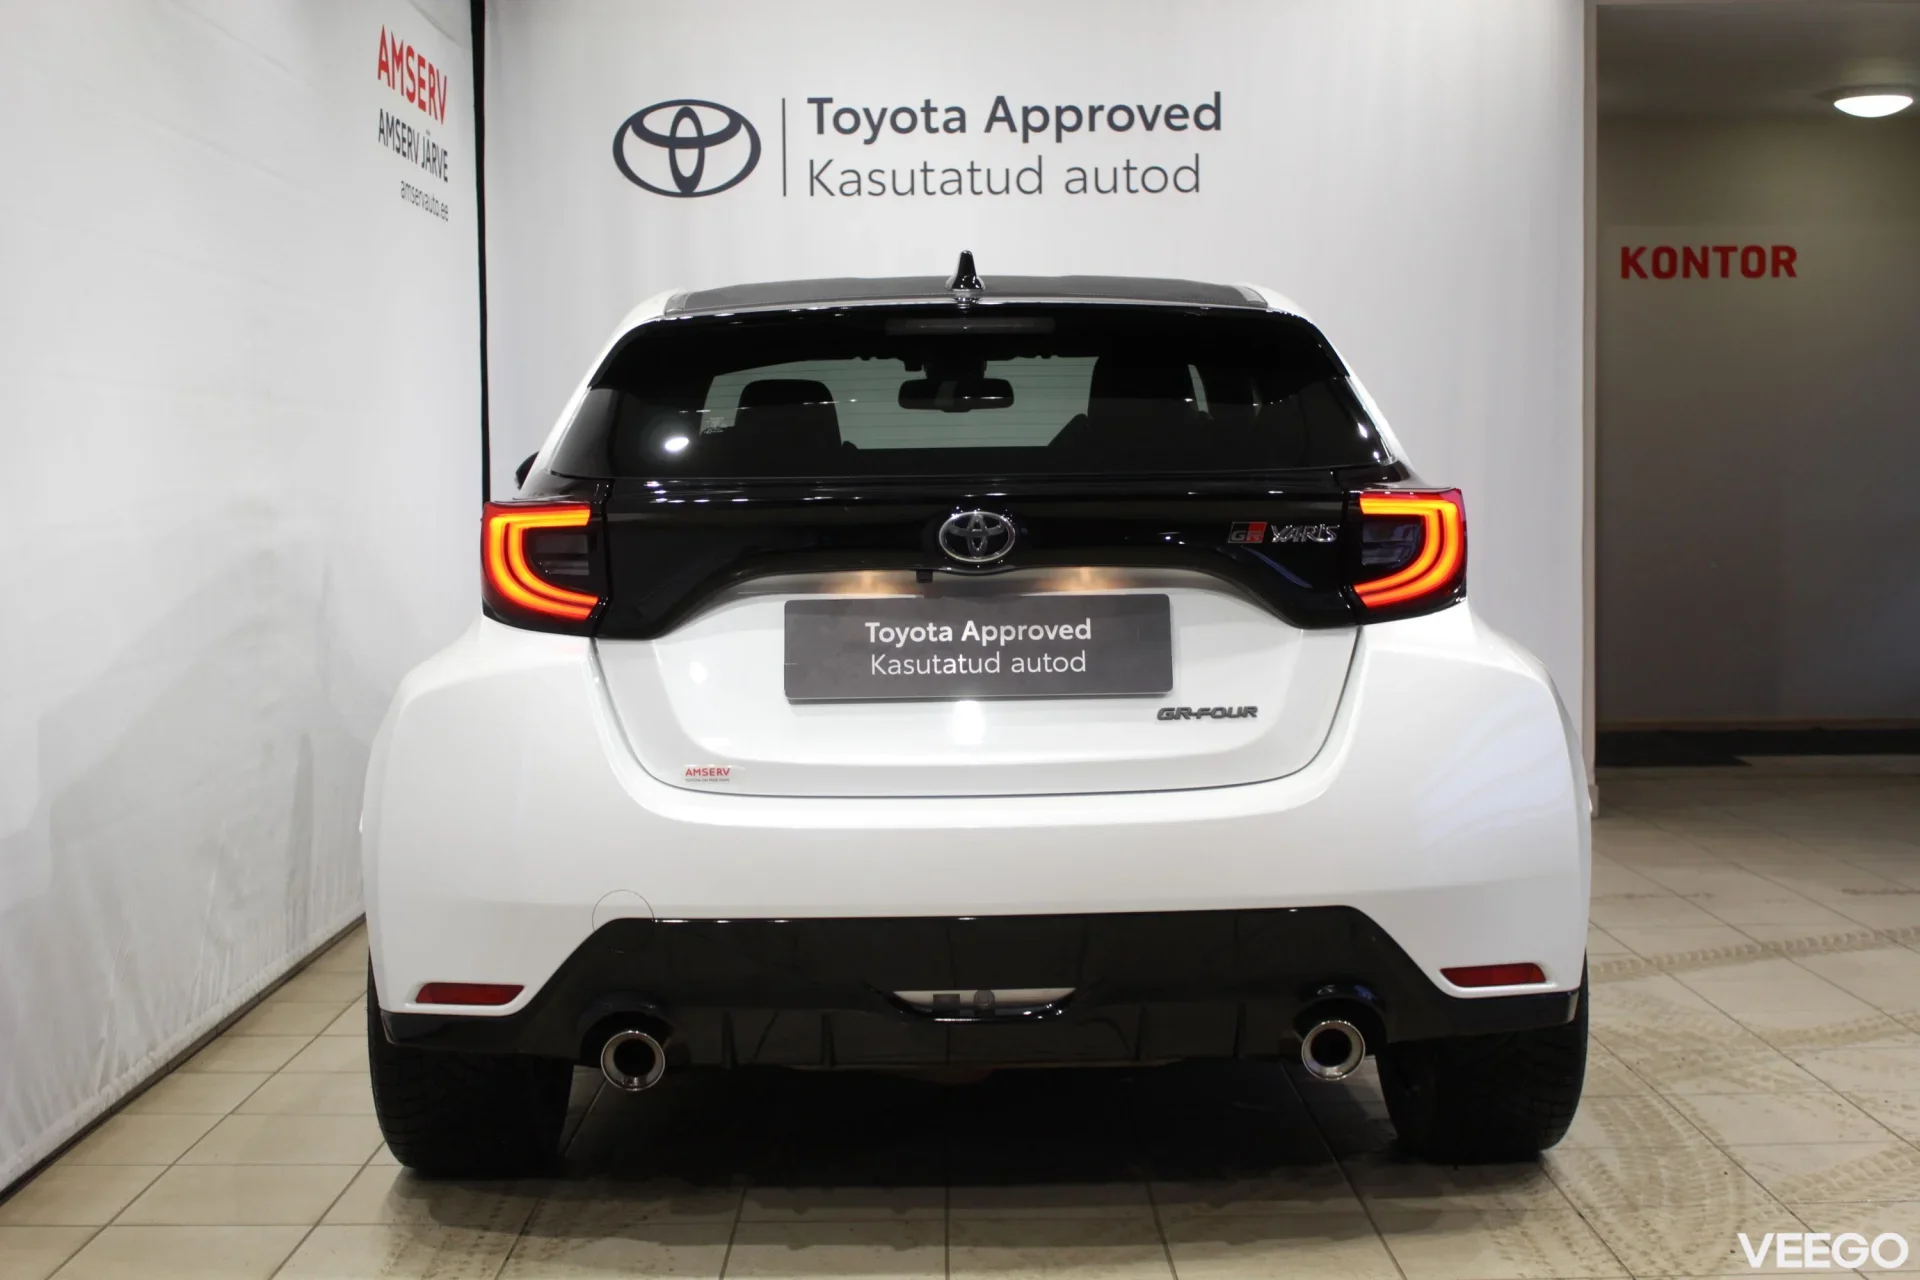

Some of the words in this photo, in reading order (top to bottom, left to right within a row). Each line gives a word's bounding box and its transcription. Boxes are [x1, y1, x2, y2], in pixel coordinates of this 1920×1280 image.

[377, 24, 448, 125] AMSERV
[807, 97, 967, 145] Toyota
[984, 91, 1223, 144] Approved
[378, 107, 420, 165] AMSERV
[421, 129, 449, 183] JÄRVE
[808, 155, 1043, 197] Kasutatud
[1064, 153, 1200, 195] autod
[400, 180, 449, 222] amservauto.ee
[1620, 245, 1798, 280] KONTOR
[1229, 528, 1266, 543] GR
[1271, 524, 1340, 543] YARIS
[865, 621, 953, 648] Toyota
[961, 618, 1092, 646] Approved
[871, 651, 1001, 675] Kasutatud
[1011, 650, 1086, 673] autod
[1156, 705, 1259, 721] GR-FOUR
[685, 767, 731, 777] AMSERV
